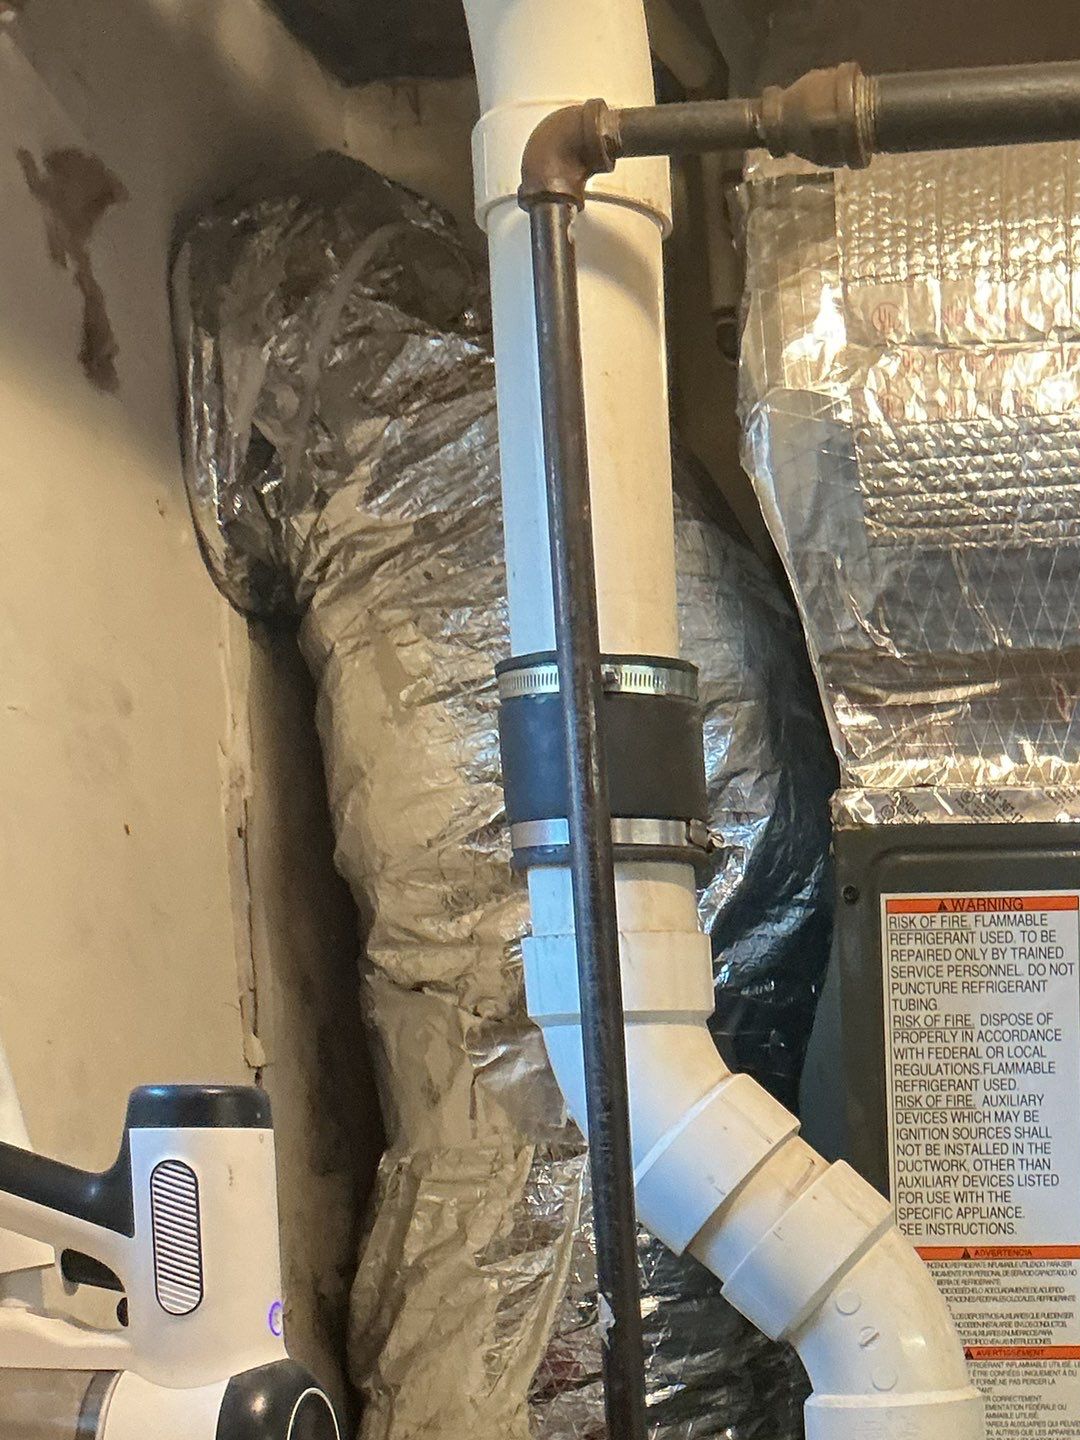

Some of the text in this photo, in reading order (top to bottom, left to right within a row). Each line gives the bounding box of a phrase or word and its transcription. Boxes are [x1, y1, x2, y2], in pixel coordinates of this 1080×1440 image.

[952, 899, 1024, 911] WARNING
[889, 914, 1048, 928] RISK OF FIRE. FLAMMABLE
[890, 930, 1056, 945] REFRIGERANT USED. TO BE
[891, 947, 1063, 962] REPAIRED ONLY BY TRAINED
[891, 963, 1074, 978] SERVICE PERSONNEL. DO NOT
[892, 980, 1048, 994] PUNCTURE REFRIGERANT
[893, 1013, 1053, 1028] RISK OF FIRE. DISPOSE OF
[893, 1029, 1062, 1044] PROPERLY IN ACCORDANCE
[894, 1046, 1047, 1060] WITH FEDERAL OR LOCAL
[895, 1079, 1019, 1092] REFRIGERANT USED.
[895, 1094, 1044, 1108] RISK OF FIRE. AUXILIARY
[896, 1110, 1039, 1124] DEVICES WHICH MAY BE
[896, 1127, 1051, 1140] IGNITION SOURCES SHALL
[897, 1142, 1051, 1156] NOT BE INSTALLED IN THE
[897, 1158, 1050, 1172] DUCTWORK, OTHER THAN
[898, 1174, 1059, 1188] AUXILIARY DEVICES LISTED
[899, 1190, 1011, 1204] FOR USE WITH THE
[899, 1206, 1025, 1220] SPECIFIC APPLIANCE.
[900, 1222, 1017, 1236] SEE INSTRUCTIONS.
